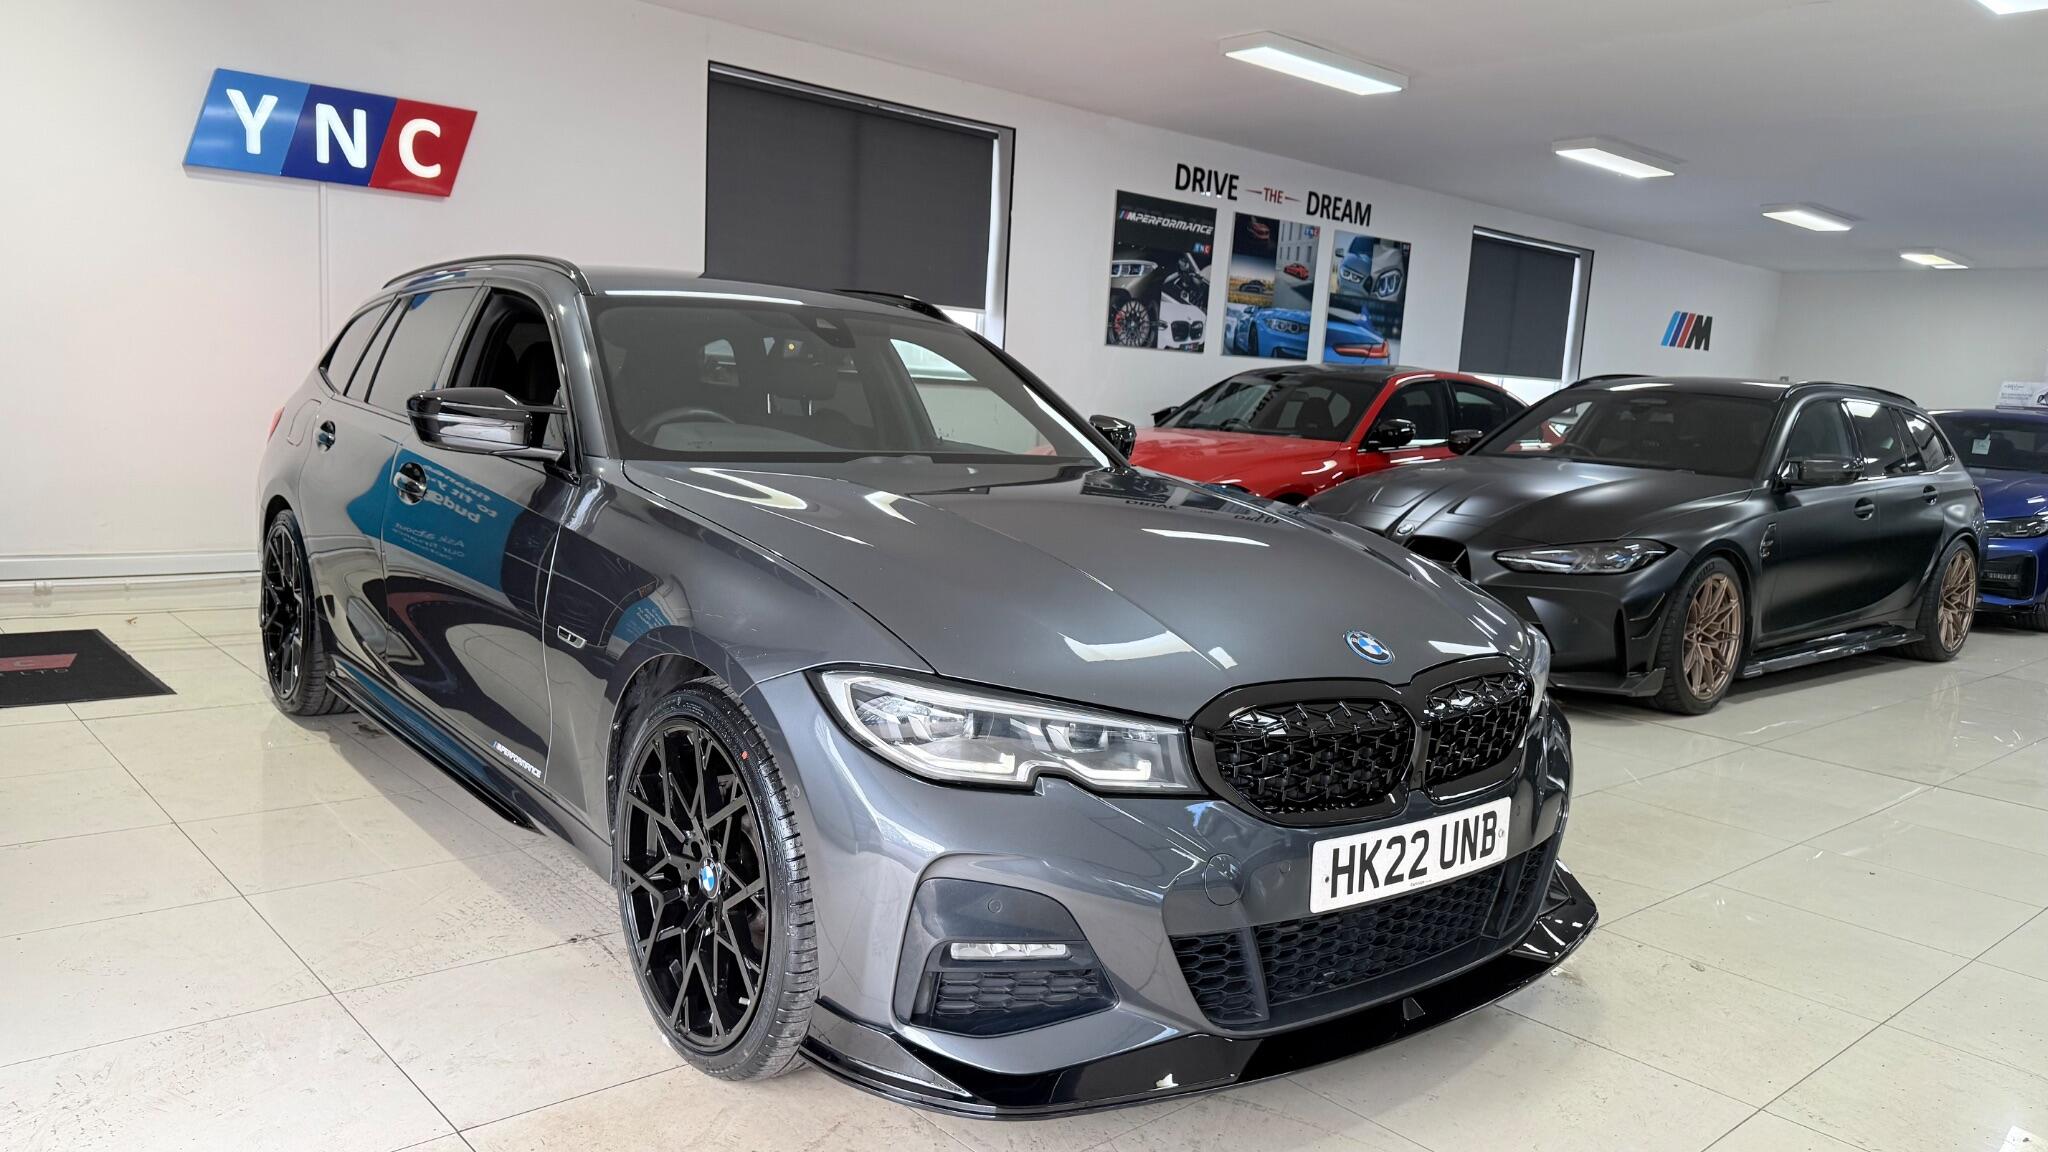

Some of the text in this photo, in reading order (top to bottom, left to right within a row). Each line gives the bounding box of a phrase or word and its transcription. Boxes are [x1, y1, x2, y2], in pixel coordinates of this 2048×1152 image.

[226, 88, 441, 178] YNC
[1175, 163, 1372, 227] DRIVE THE DREAM
[1331, 810, 1498, 898] HK22 UNB
